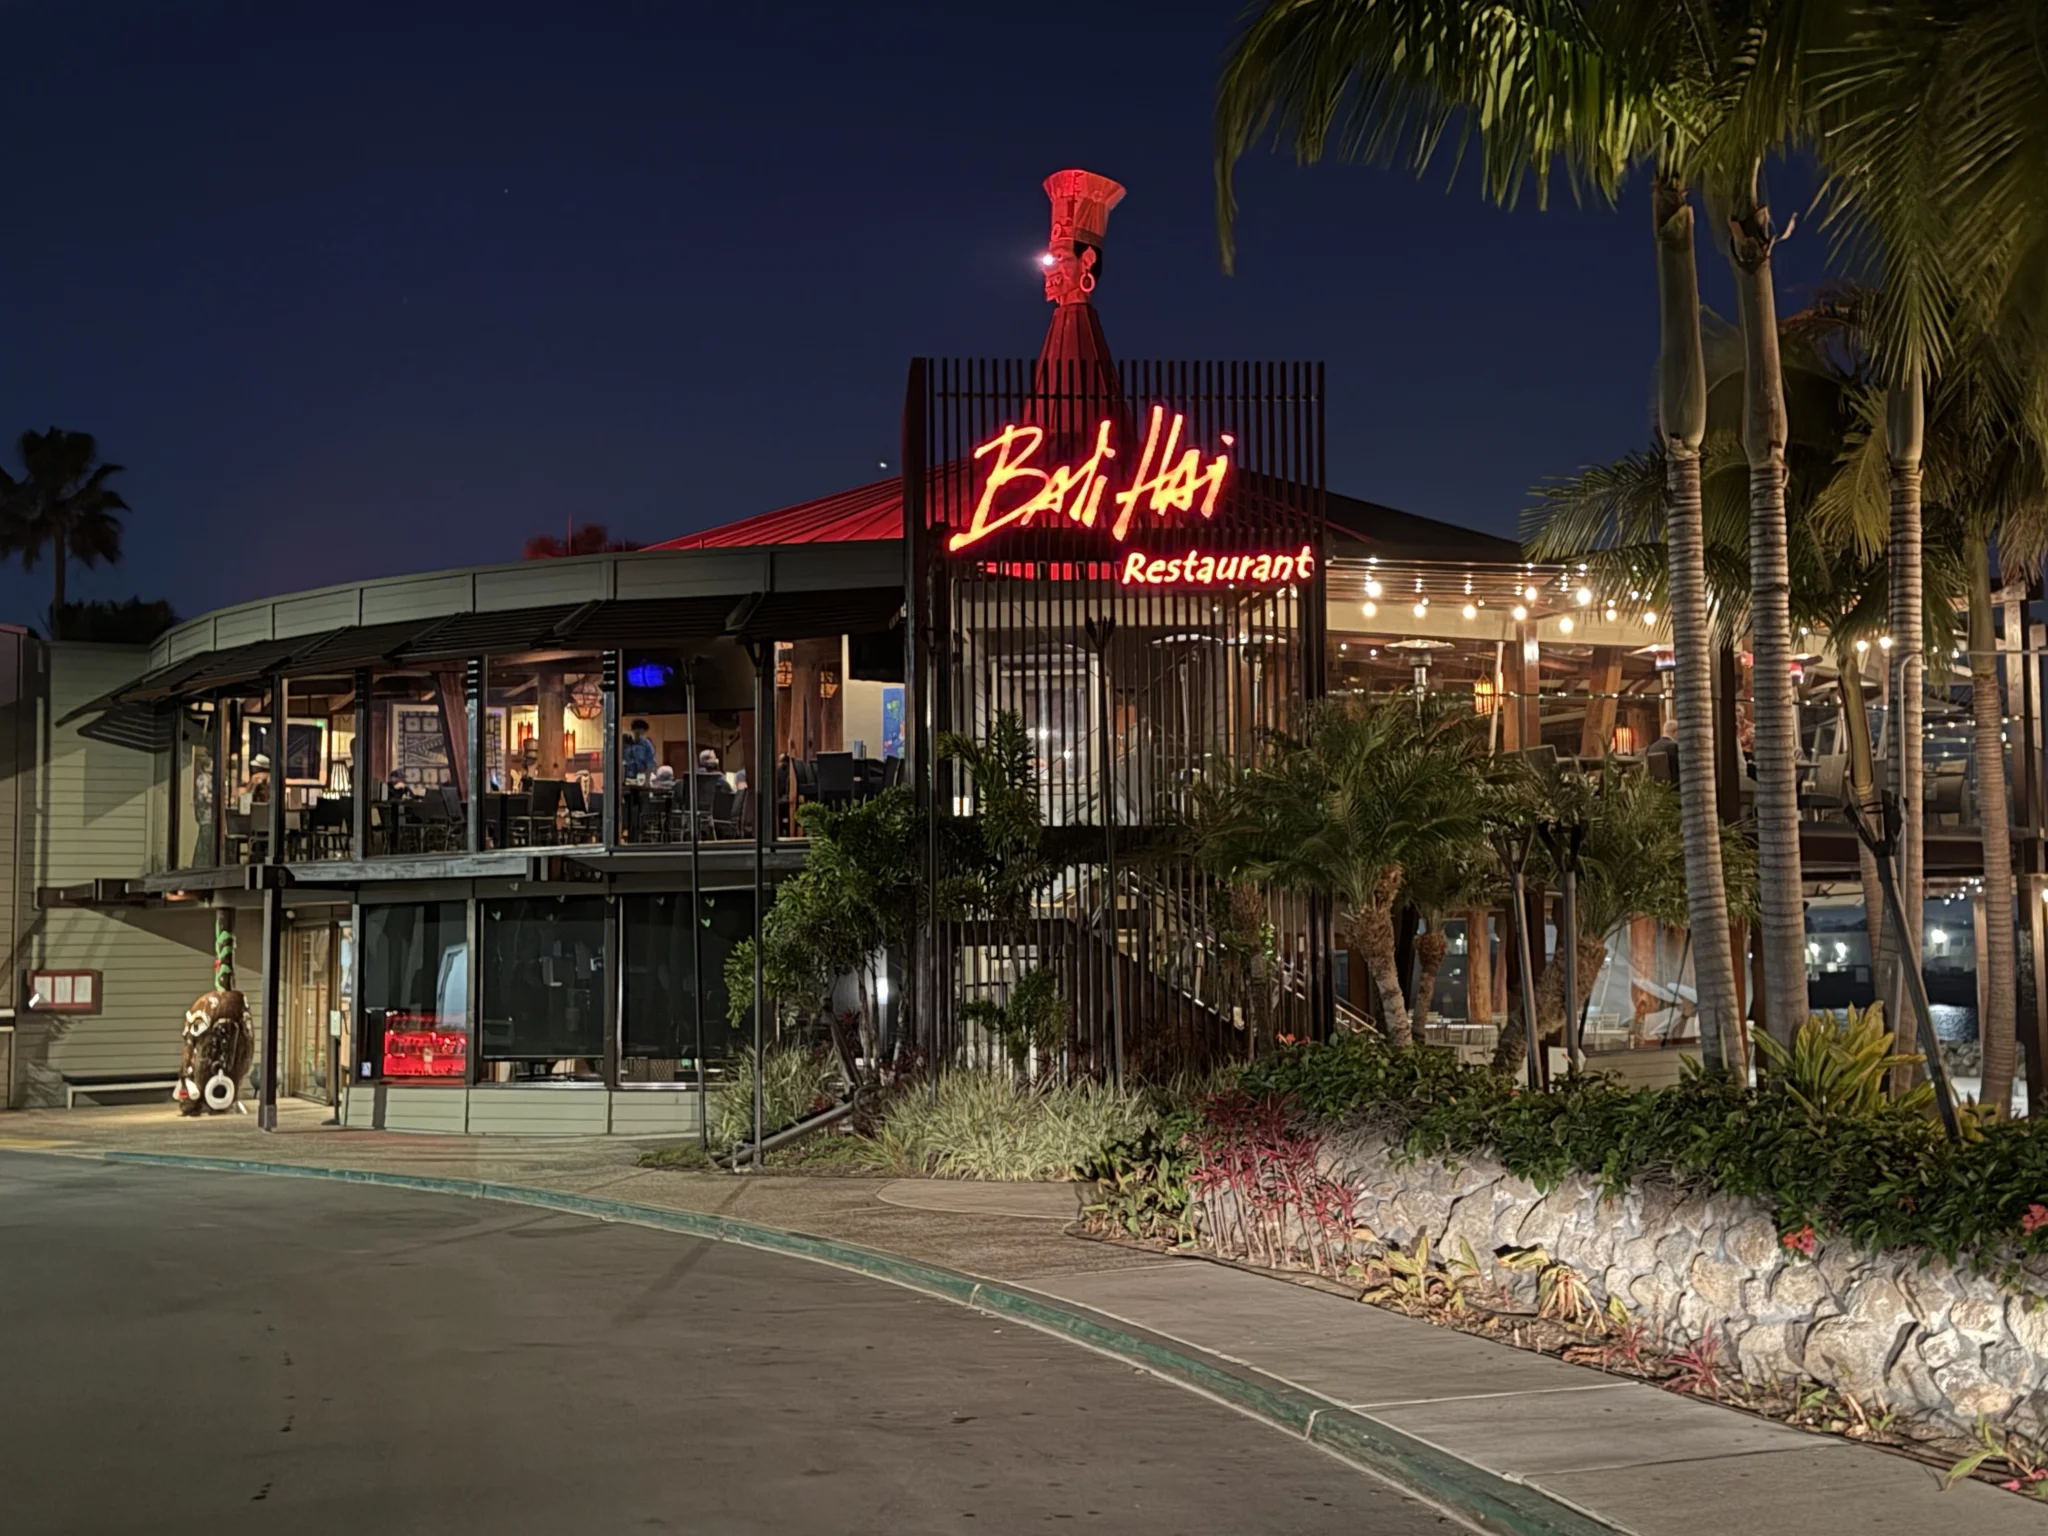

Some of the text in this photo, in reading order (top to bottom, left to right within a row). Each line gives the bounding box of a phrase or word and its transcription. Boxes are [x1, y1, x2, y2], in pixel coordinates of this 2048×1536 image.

[949, 405, 1235, 552] Bali Hai
[1122, 545, 1312, 585] Restaurant
